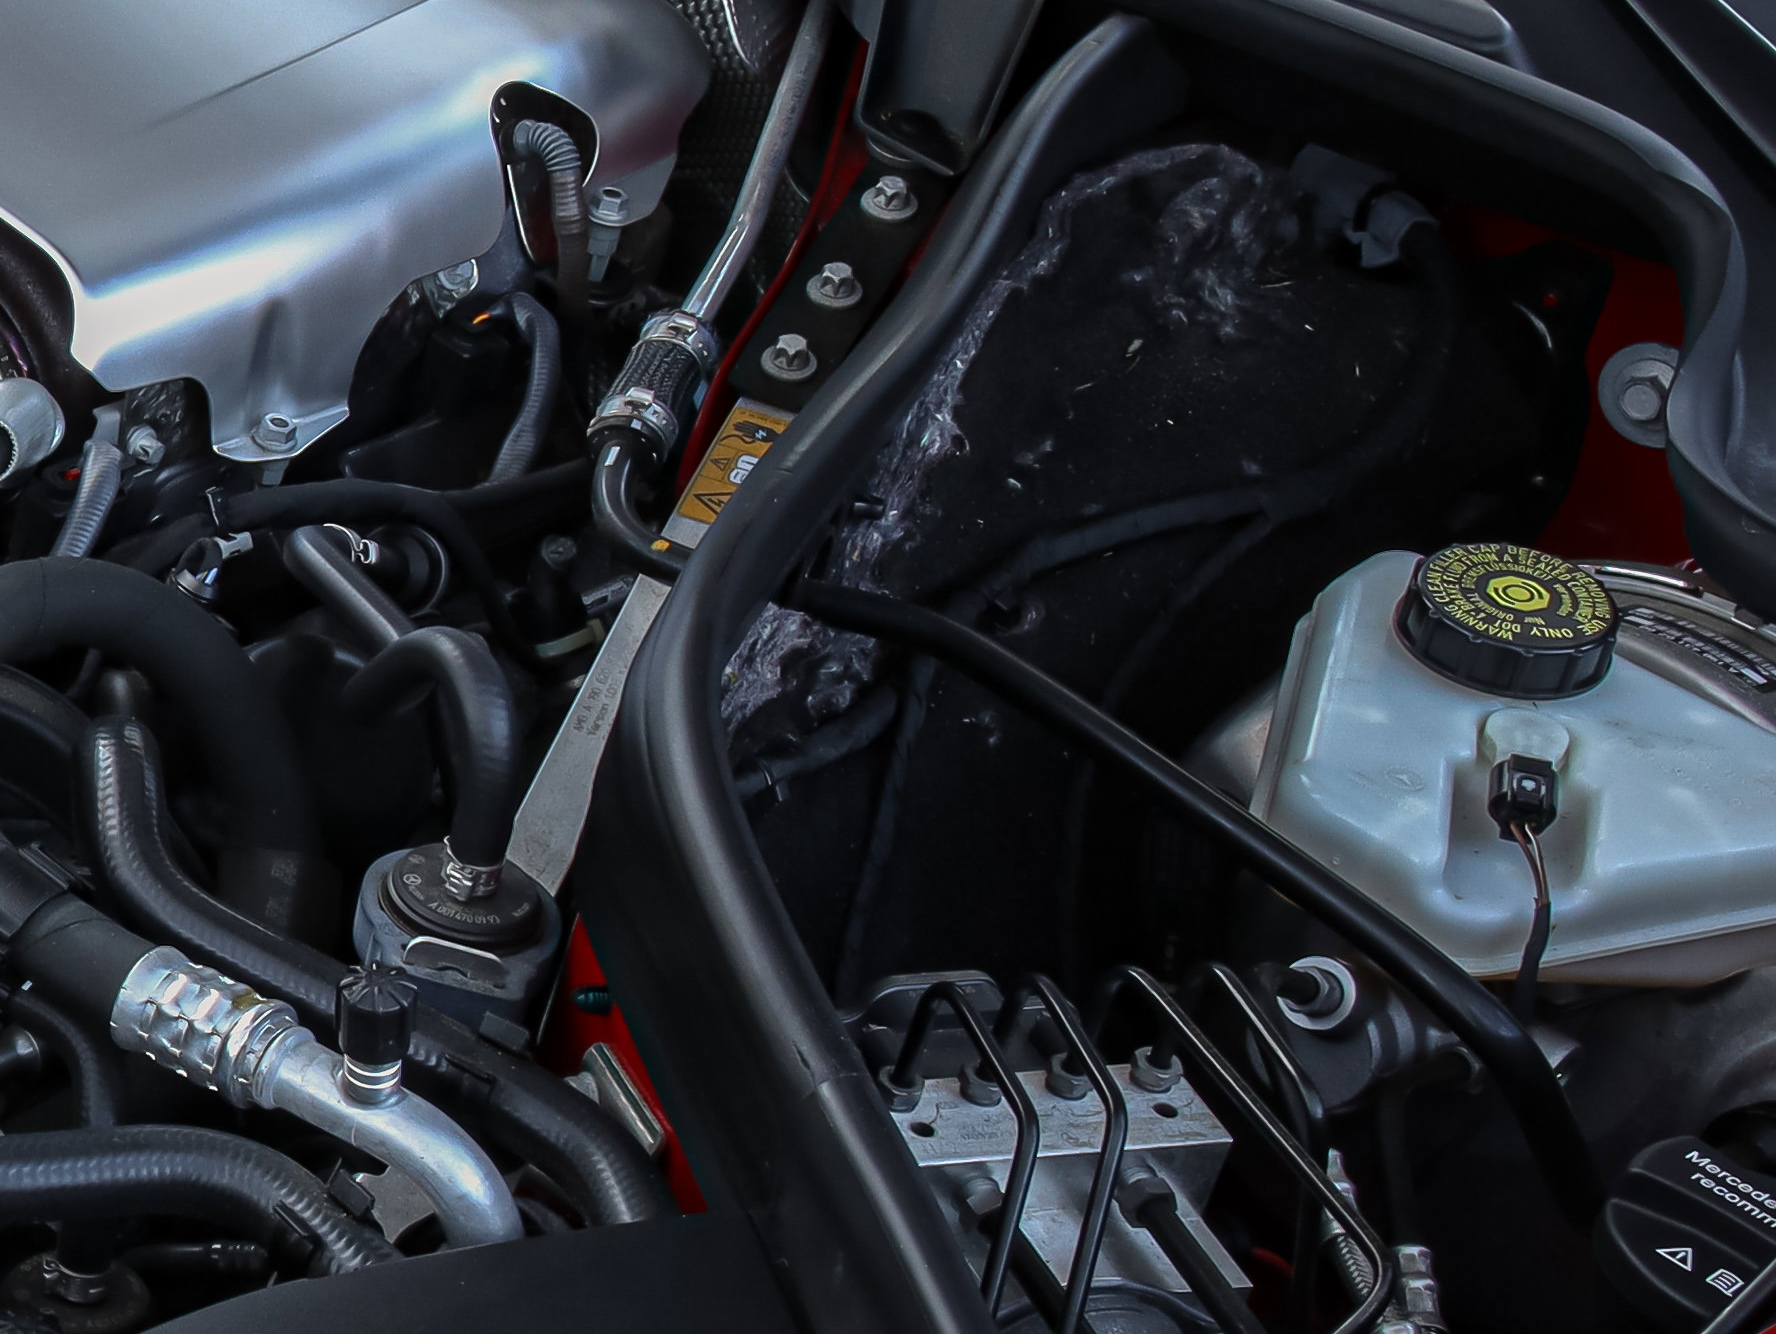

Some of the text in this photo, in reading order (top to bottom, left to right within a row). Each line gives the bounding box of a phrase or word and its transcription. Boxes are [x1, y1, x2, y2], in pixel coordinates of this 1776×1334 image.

[1467, 543, 1500, 556] CAP
[1429, 547, 1468, 572] FILLER
[1461, 552, 1499, 567] FROM
[1503, 553, 1513, 563] A
[1507, 545, 1574, 575] BEFORE
[1426, 571, 1451, 603] CLEAN
[1444, 604, 1514, 641] WARNING
[1494, 619, 1521, 633] DOT
[1529, 626, 1574, 639] ONLY
